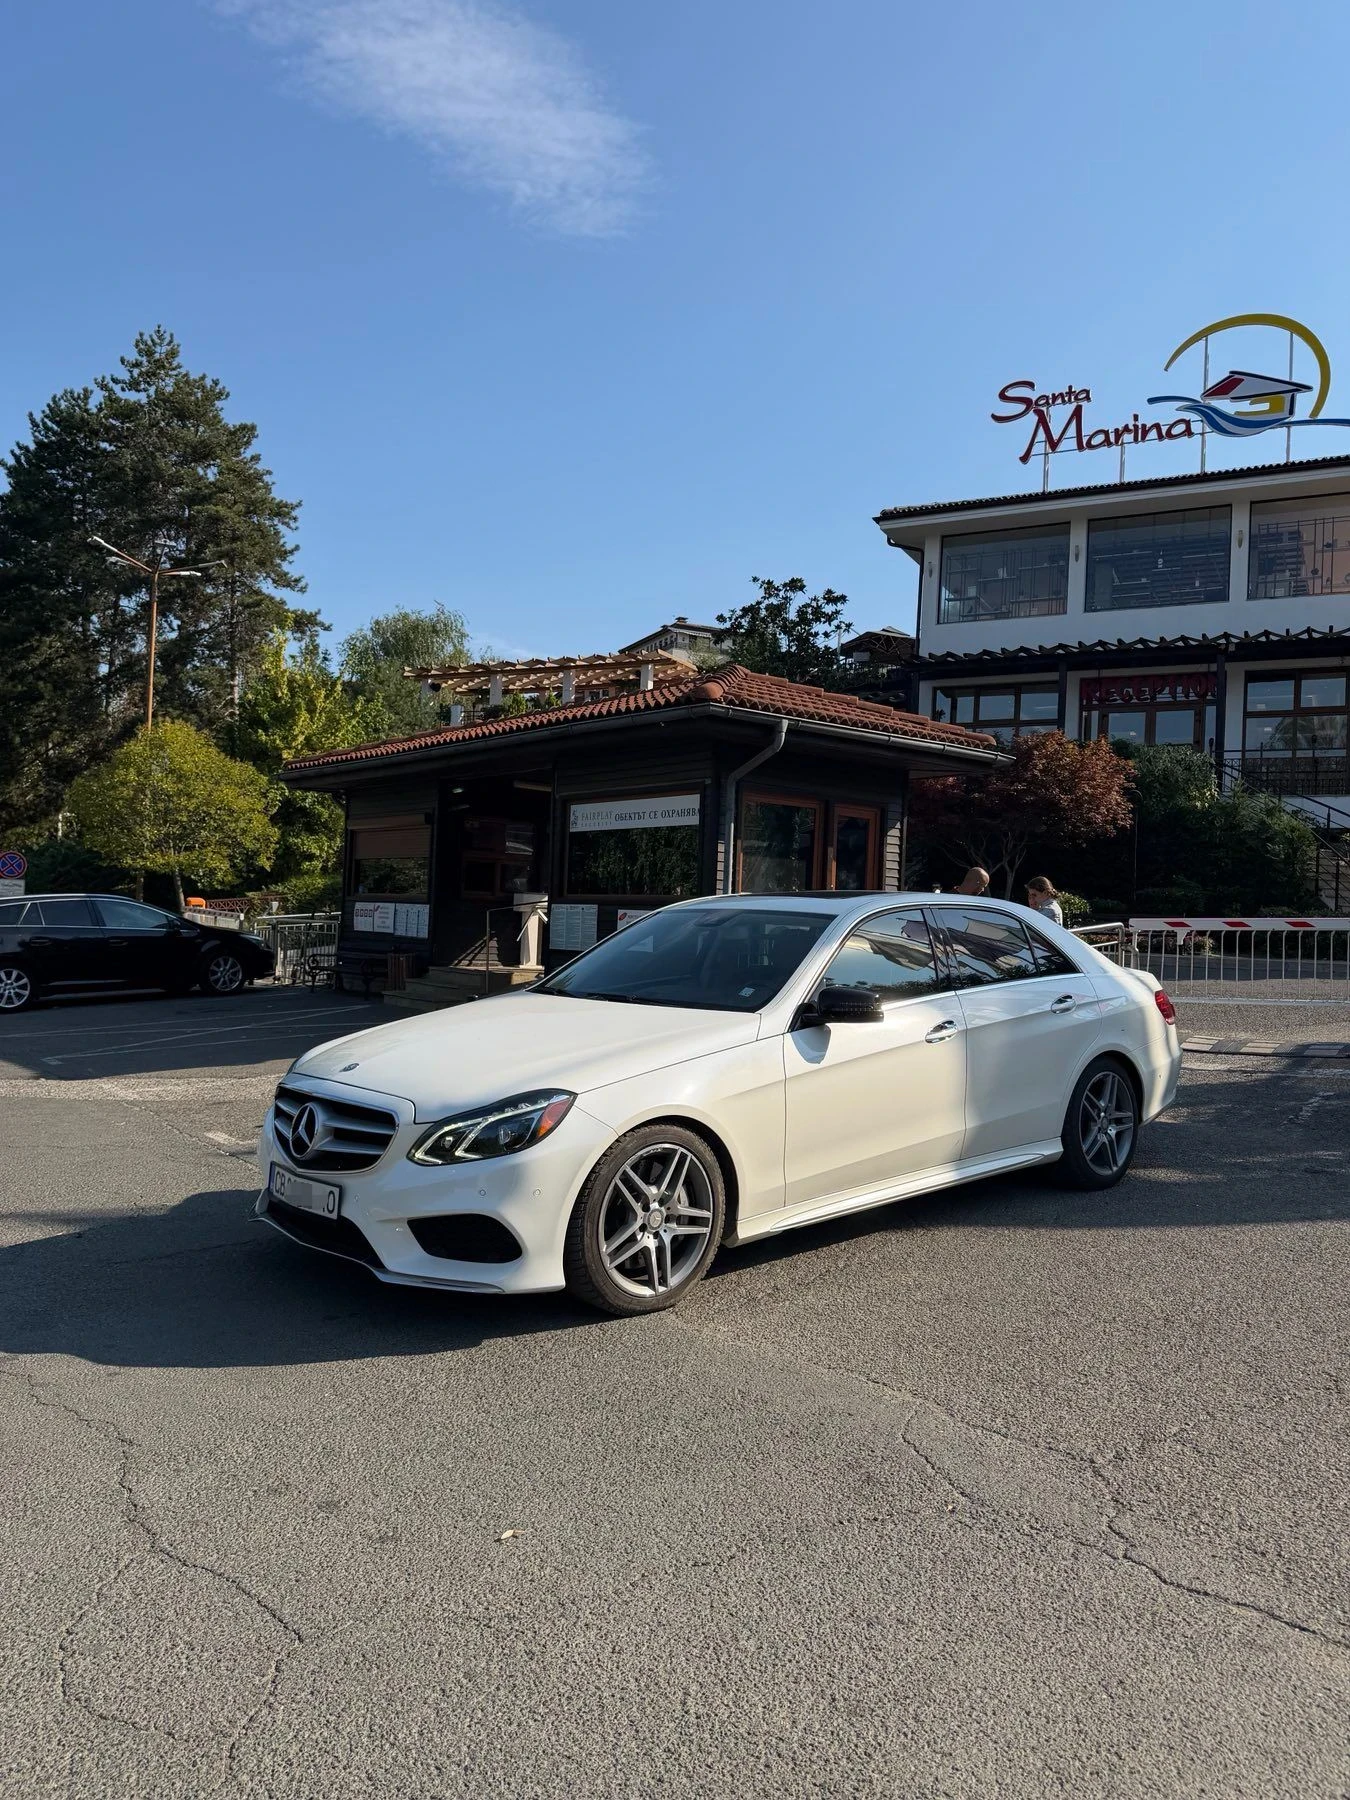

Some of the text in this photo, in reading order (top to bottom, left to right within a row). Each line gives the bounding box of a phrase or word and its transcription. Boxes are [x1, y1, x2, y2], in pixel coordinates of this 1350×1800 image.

[991, 380, 1092, 423] Santa
[1018, 404, 1195, 465] Marina
[614, 811, 646, 822] ОБЕКТЪТ
[648, 810, 659, 820] СЕ
